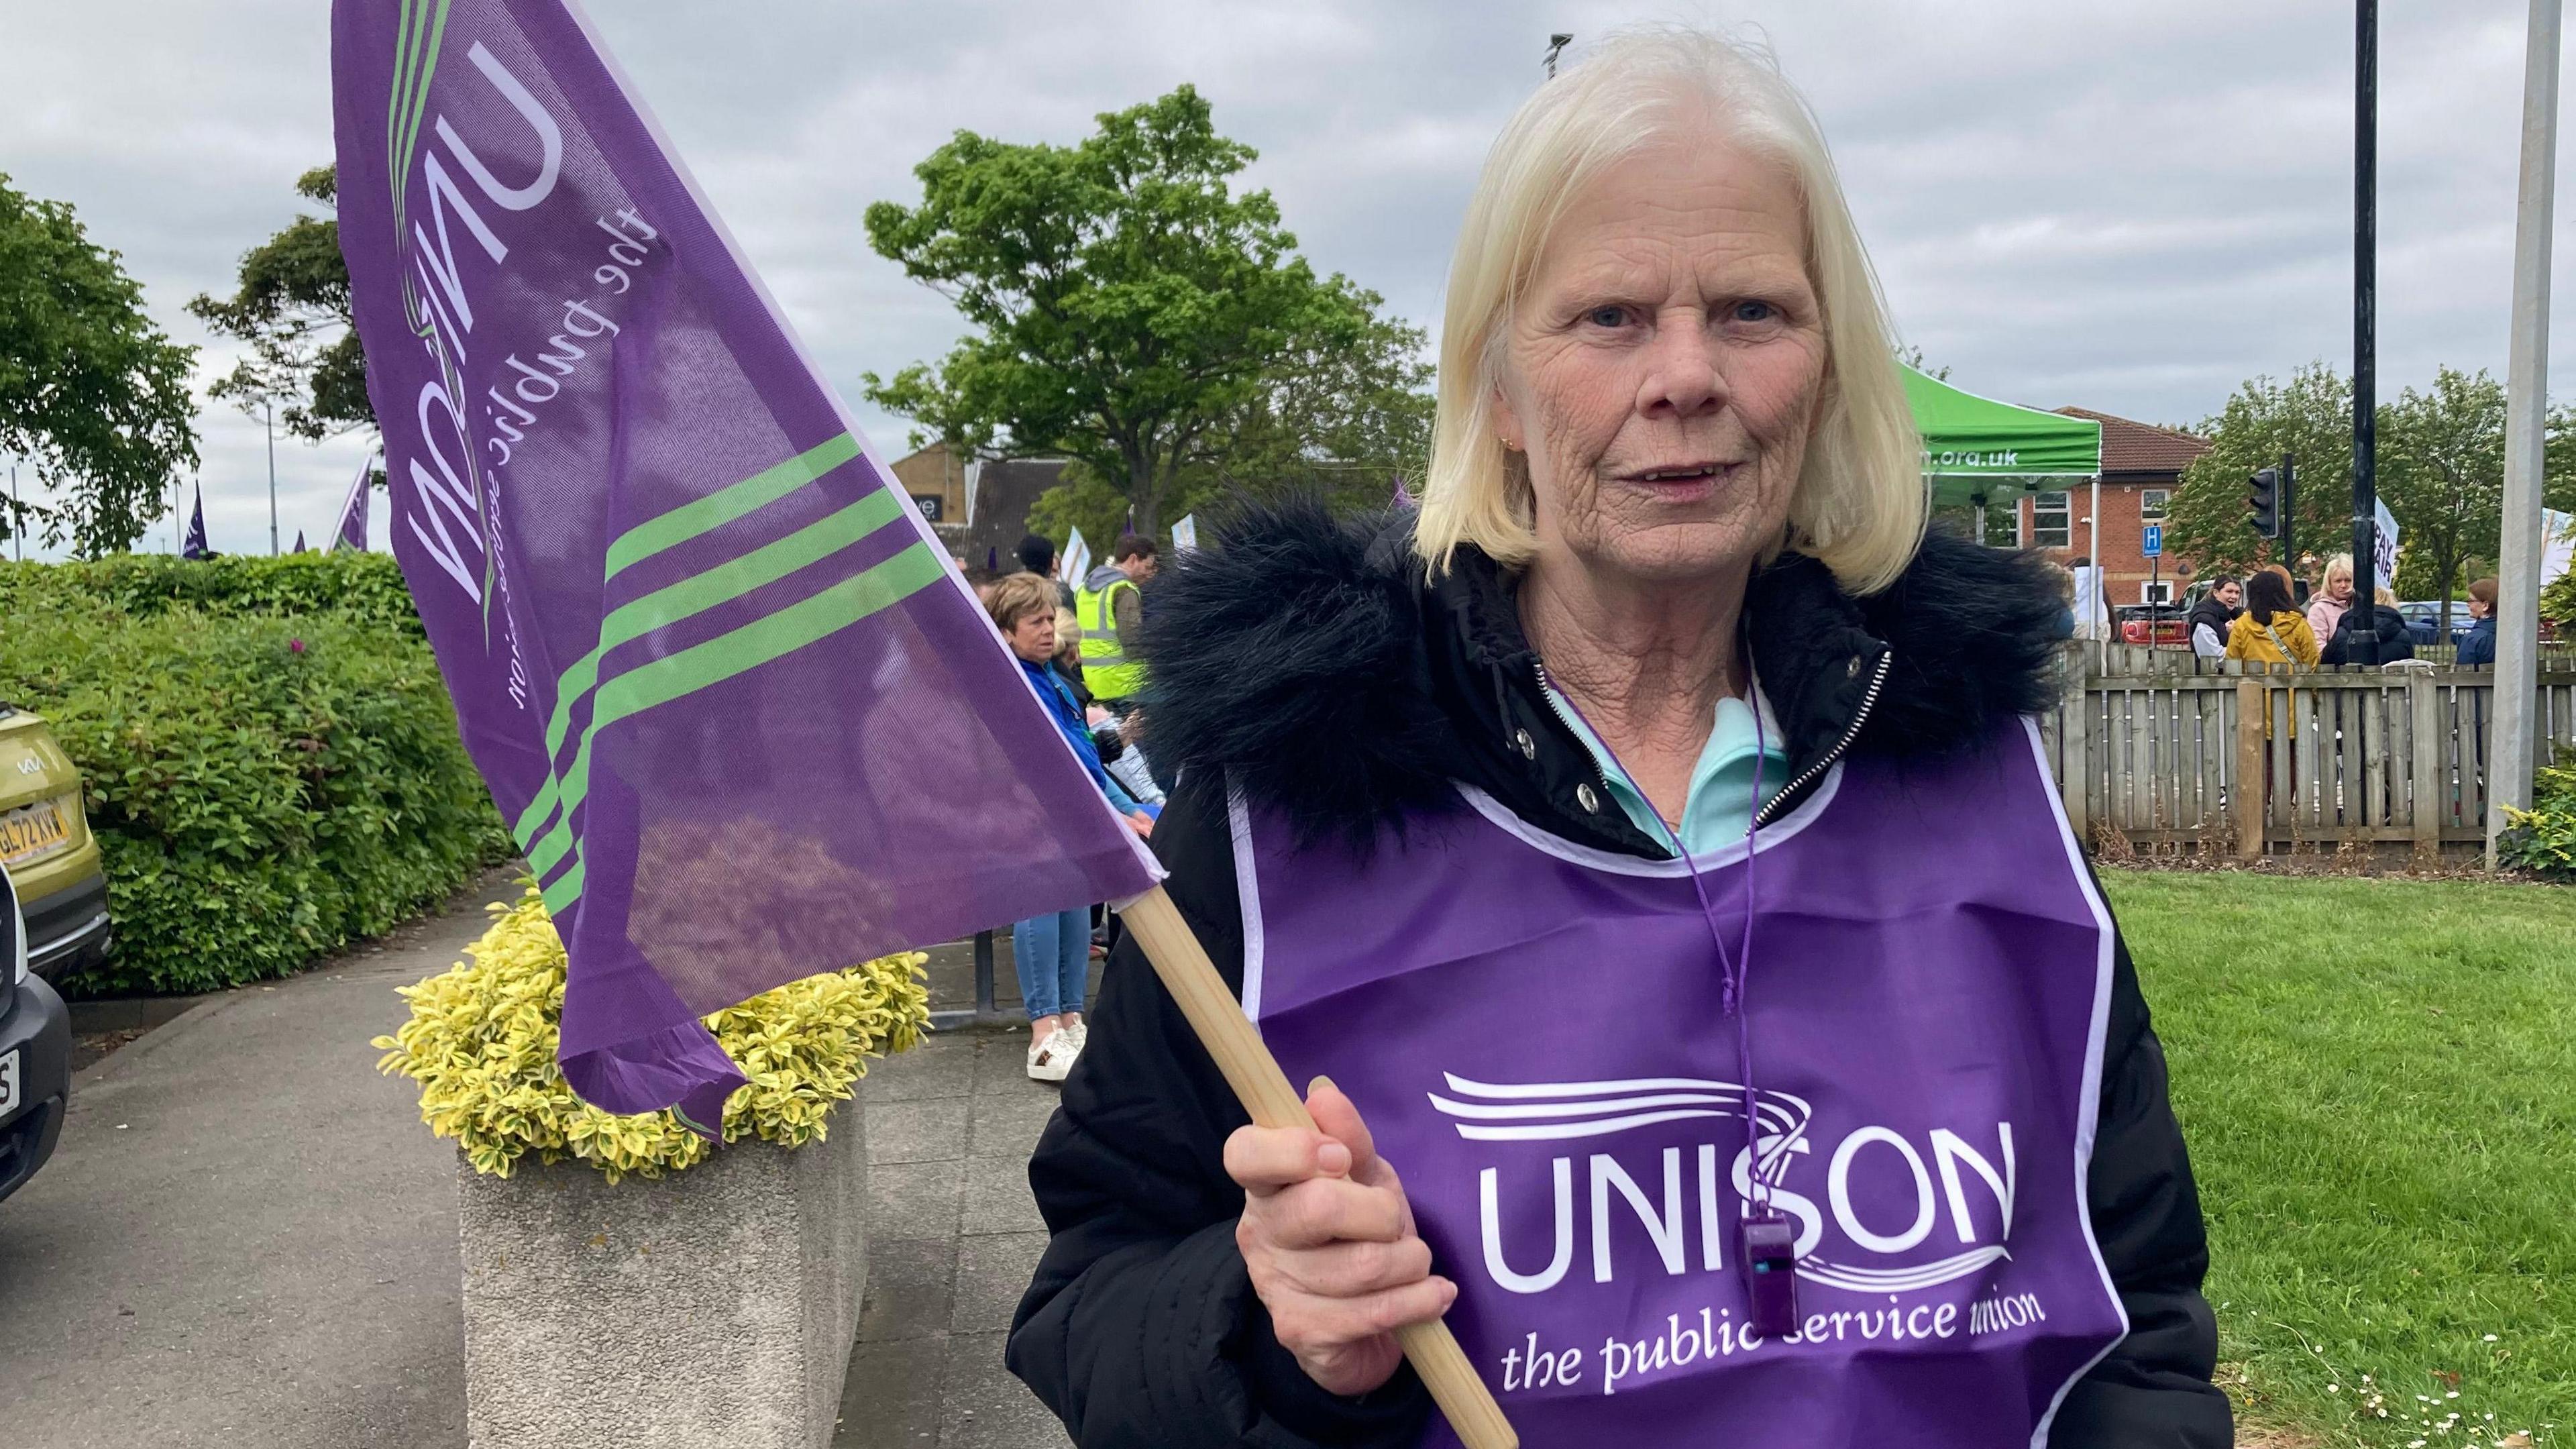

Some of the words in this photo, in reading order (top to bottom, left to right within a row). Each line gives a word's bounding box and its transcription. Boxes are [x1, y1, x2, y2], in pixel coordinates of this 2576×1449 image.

[2147, 527, 2157, 547] H
[2375, 548, 2392, 582] AIR
[1479, 1122, 2013, 1294] UNISON
[1501, 1331, 1582, 1392] the
[1600, 1305, 1764, 1394] public
[1782, 1293, 1957, 1344] ervice
[1970, 1283, 2046, 1336] union
